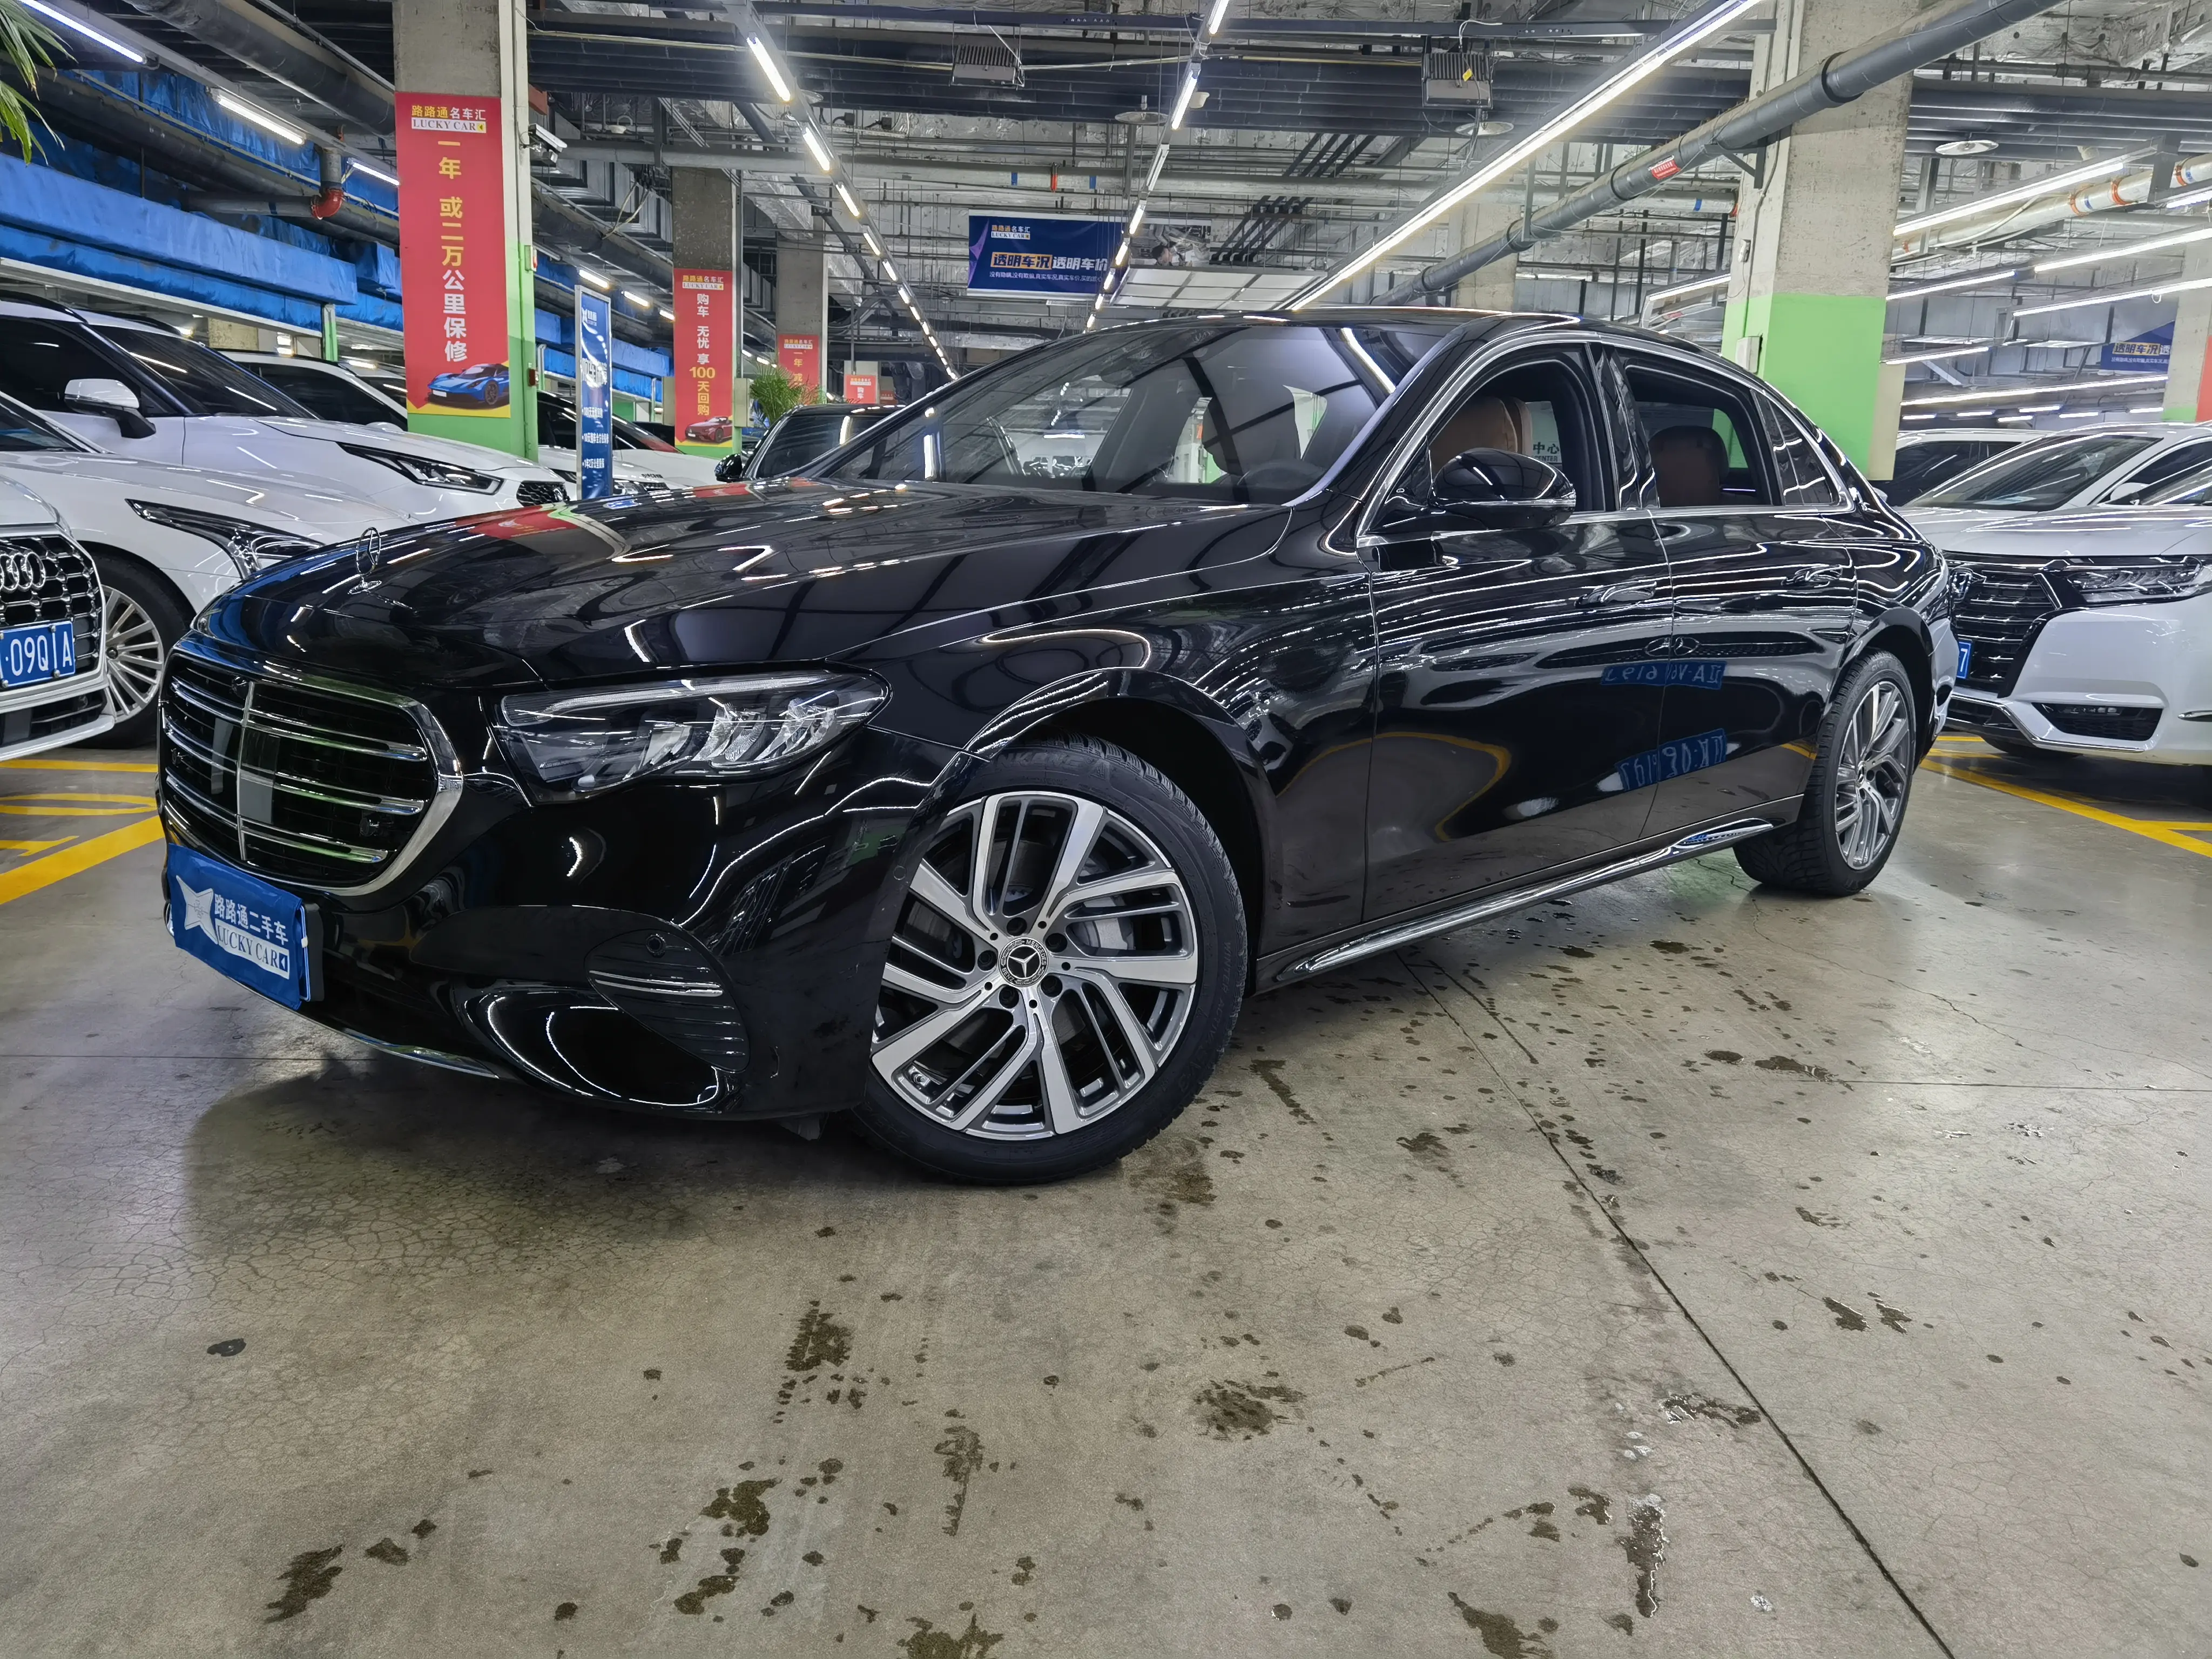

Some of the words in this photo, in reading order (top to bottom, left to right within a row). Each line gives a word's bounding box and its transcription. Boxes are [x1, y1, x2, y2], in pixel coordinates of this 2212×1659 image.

[412, 105, 486, 120] 路路通名车汇
[413, 119, 450, 129] LUCKY
[454, 122, 476, 131] CAR
[1533, 442, 1560, 454] 中心
[214, 893, 289, 946] 路路通二手车
[217, 925, 253, 956] LUCKY
[255, 942, 279, 968] CAR
[1026, 940, 1047, 966] MERCEDES
[1002, 967, 1015, 982] BENZ
[1222, 941, 1232, 994] WINTER
